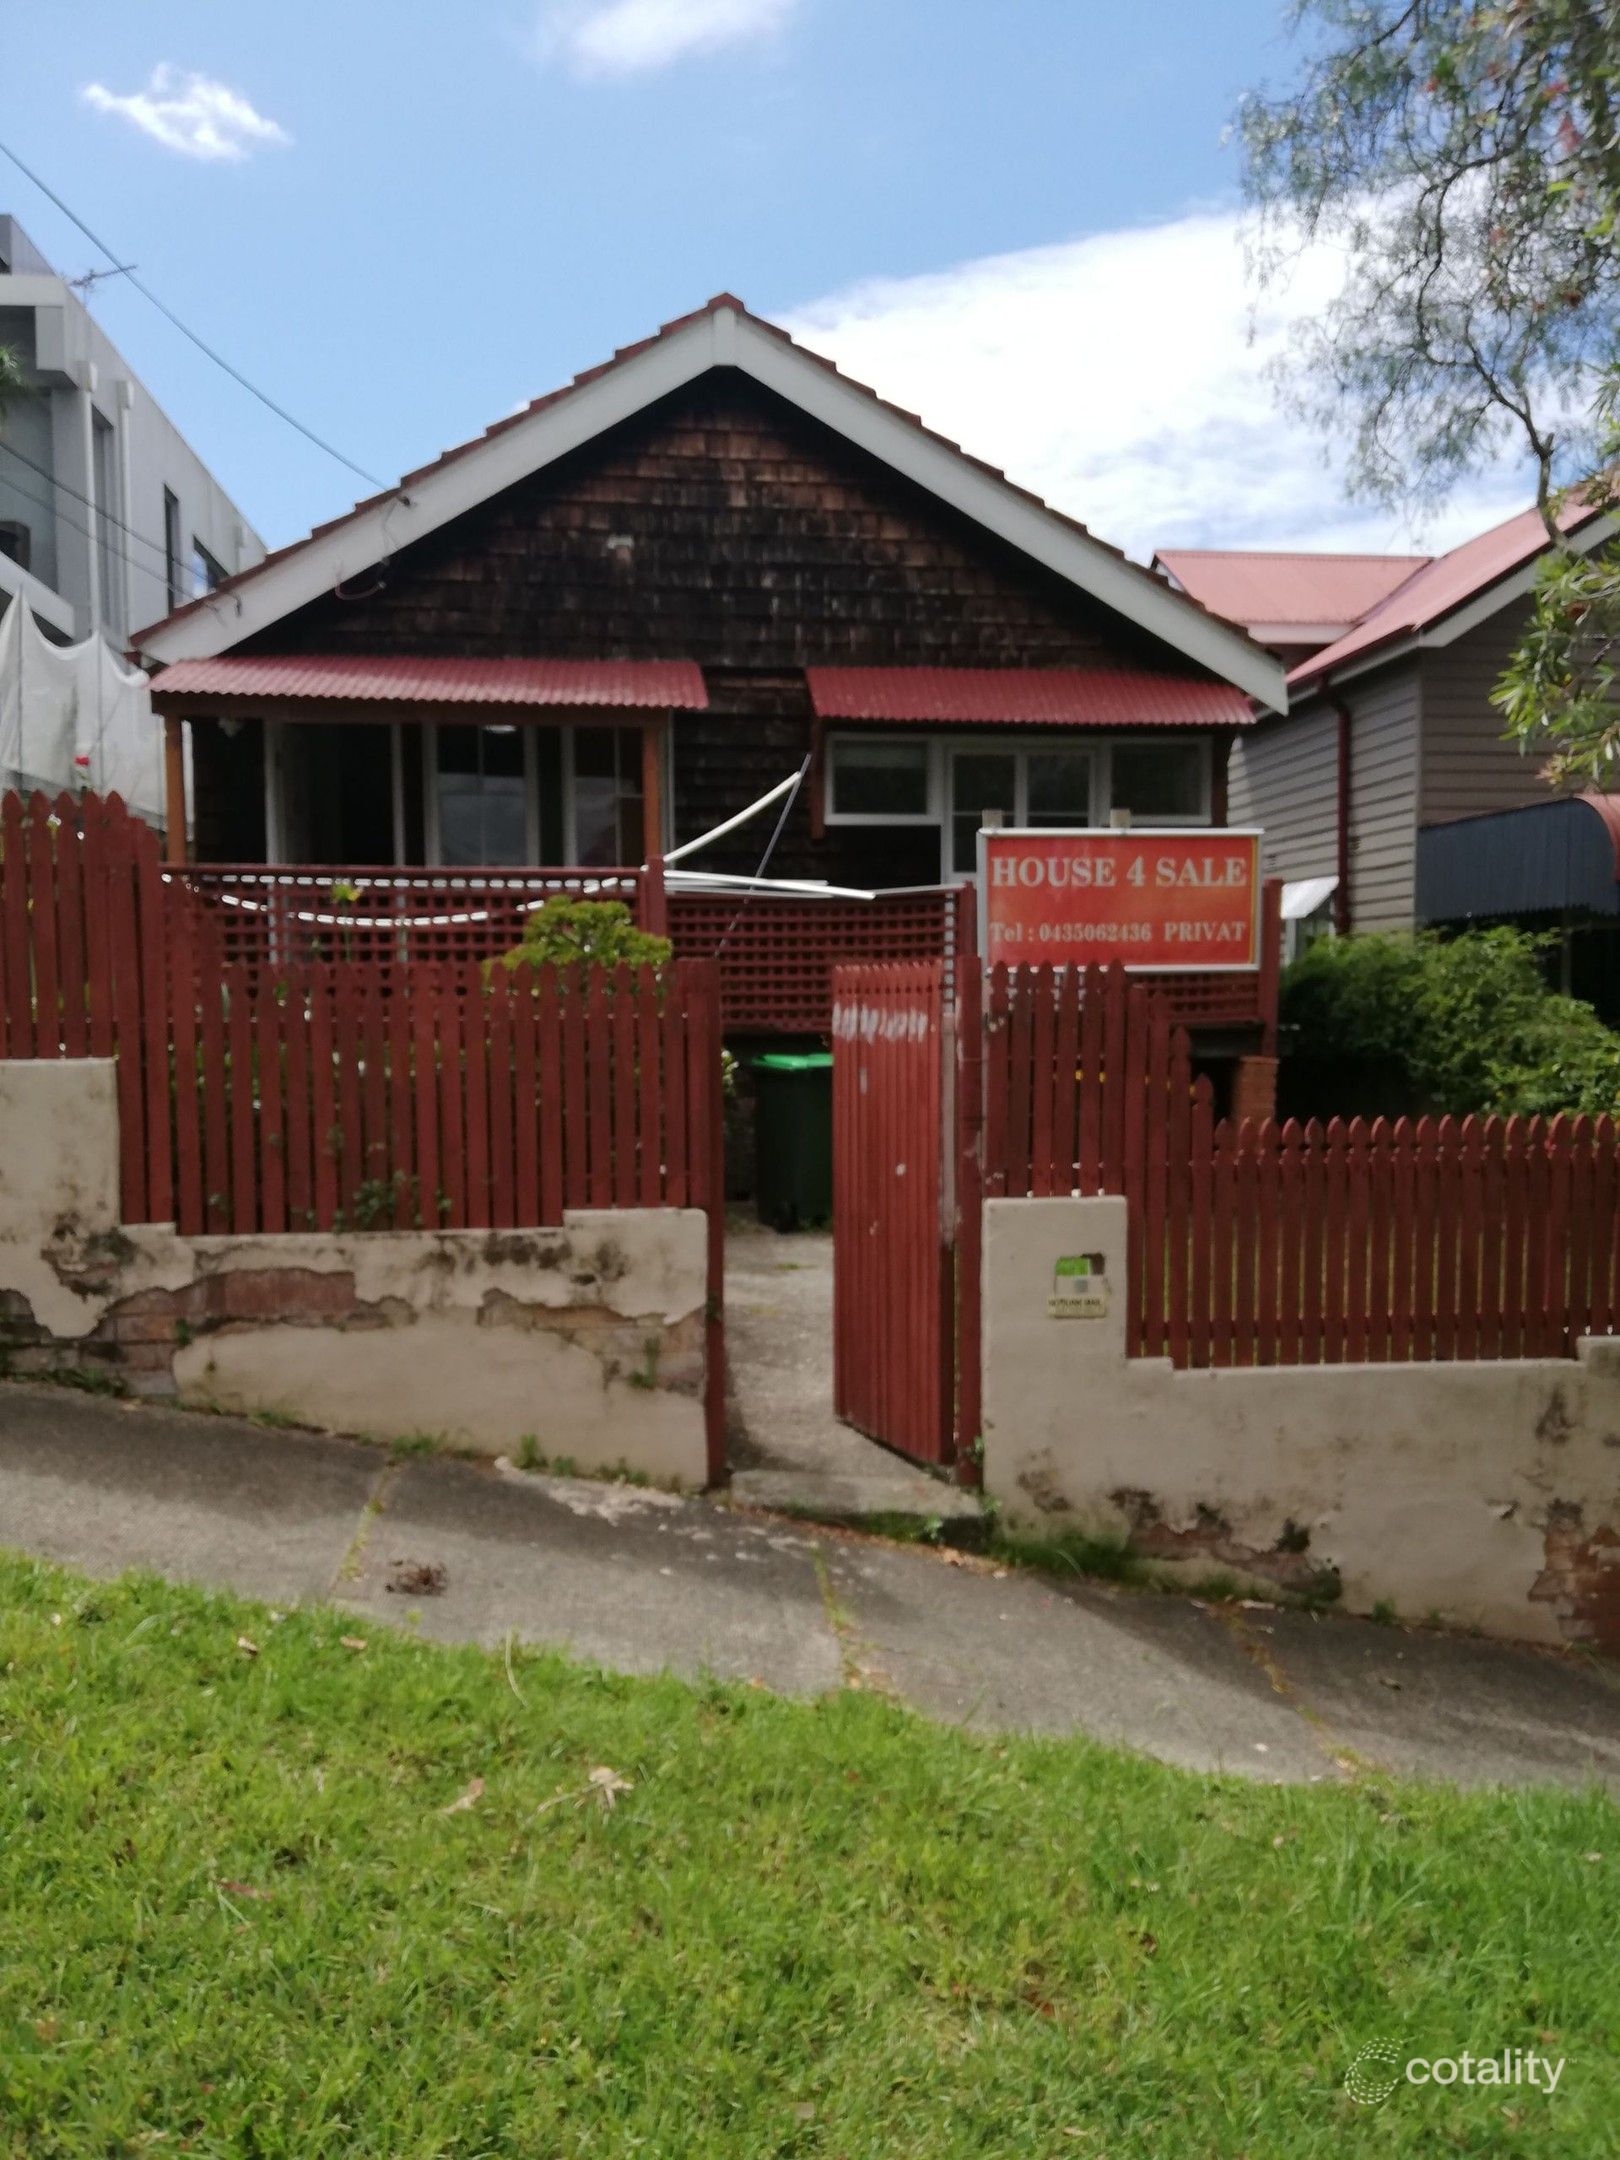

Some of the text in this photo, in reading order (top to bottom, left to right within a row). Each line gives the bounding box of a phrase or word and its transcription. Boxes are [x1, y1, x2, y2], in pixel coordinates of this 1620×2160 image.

[992, 856, 1246, 887] HOUSE 4 SALE
[1164, 921, 1246, 942] PRIVAT
